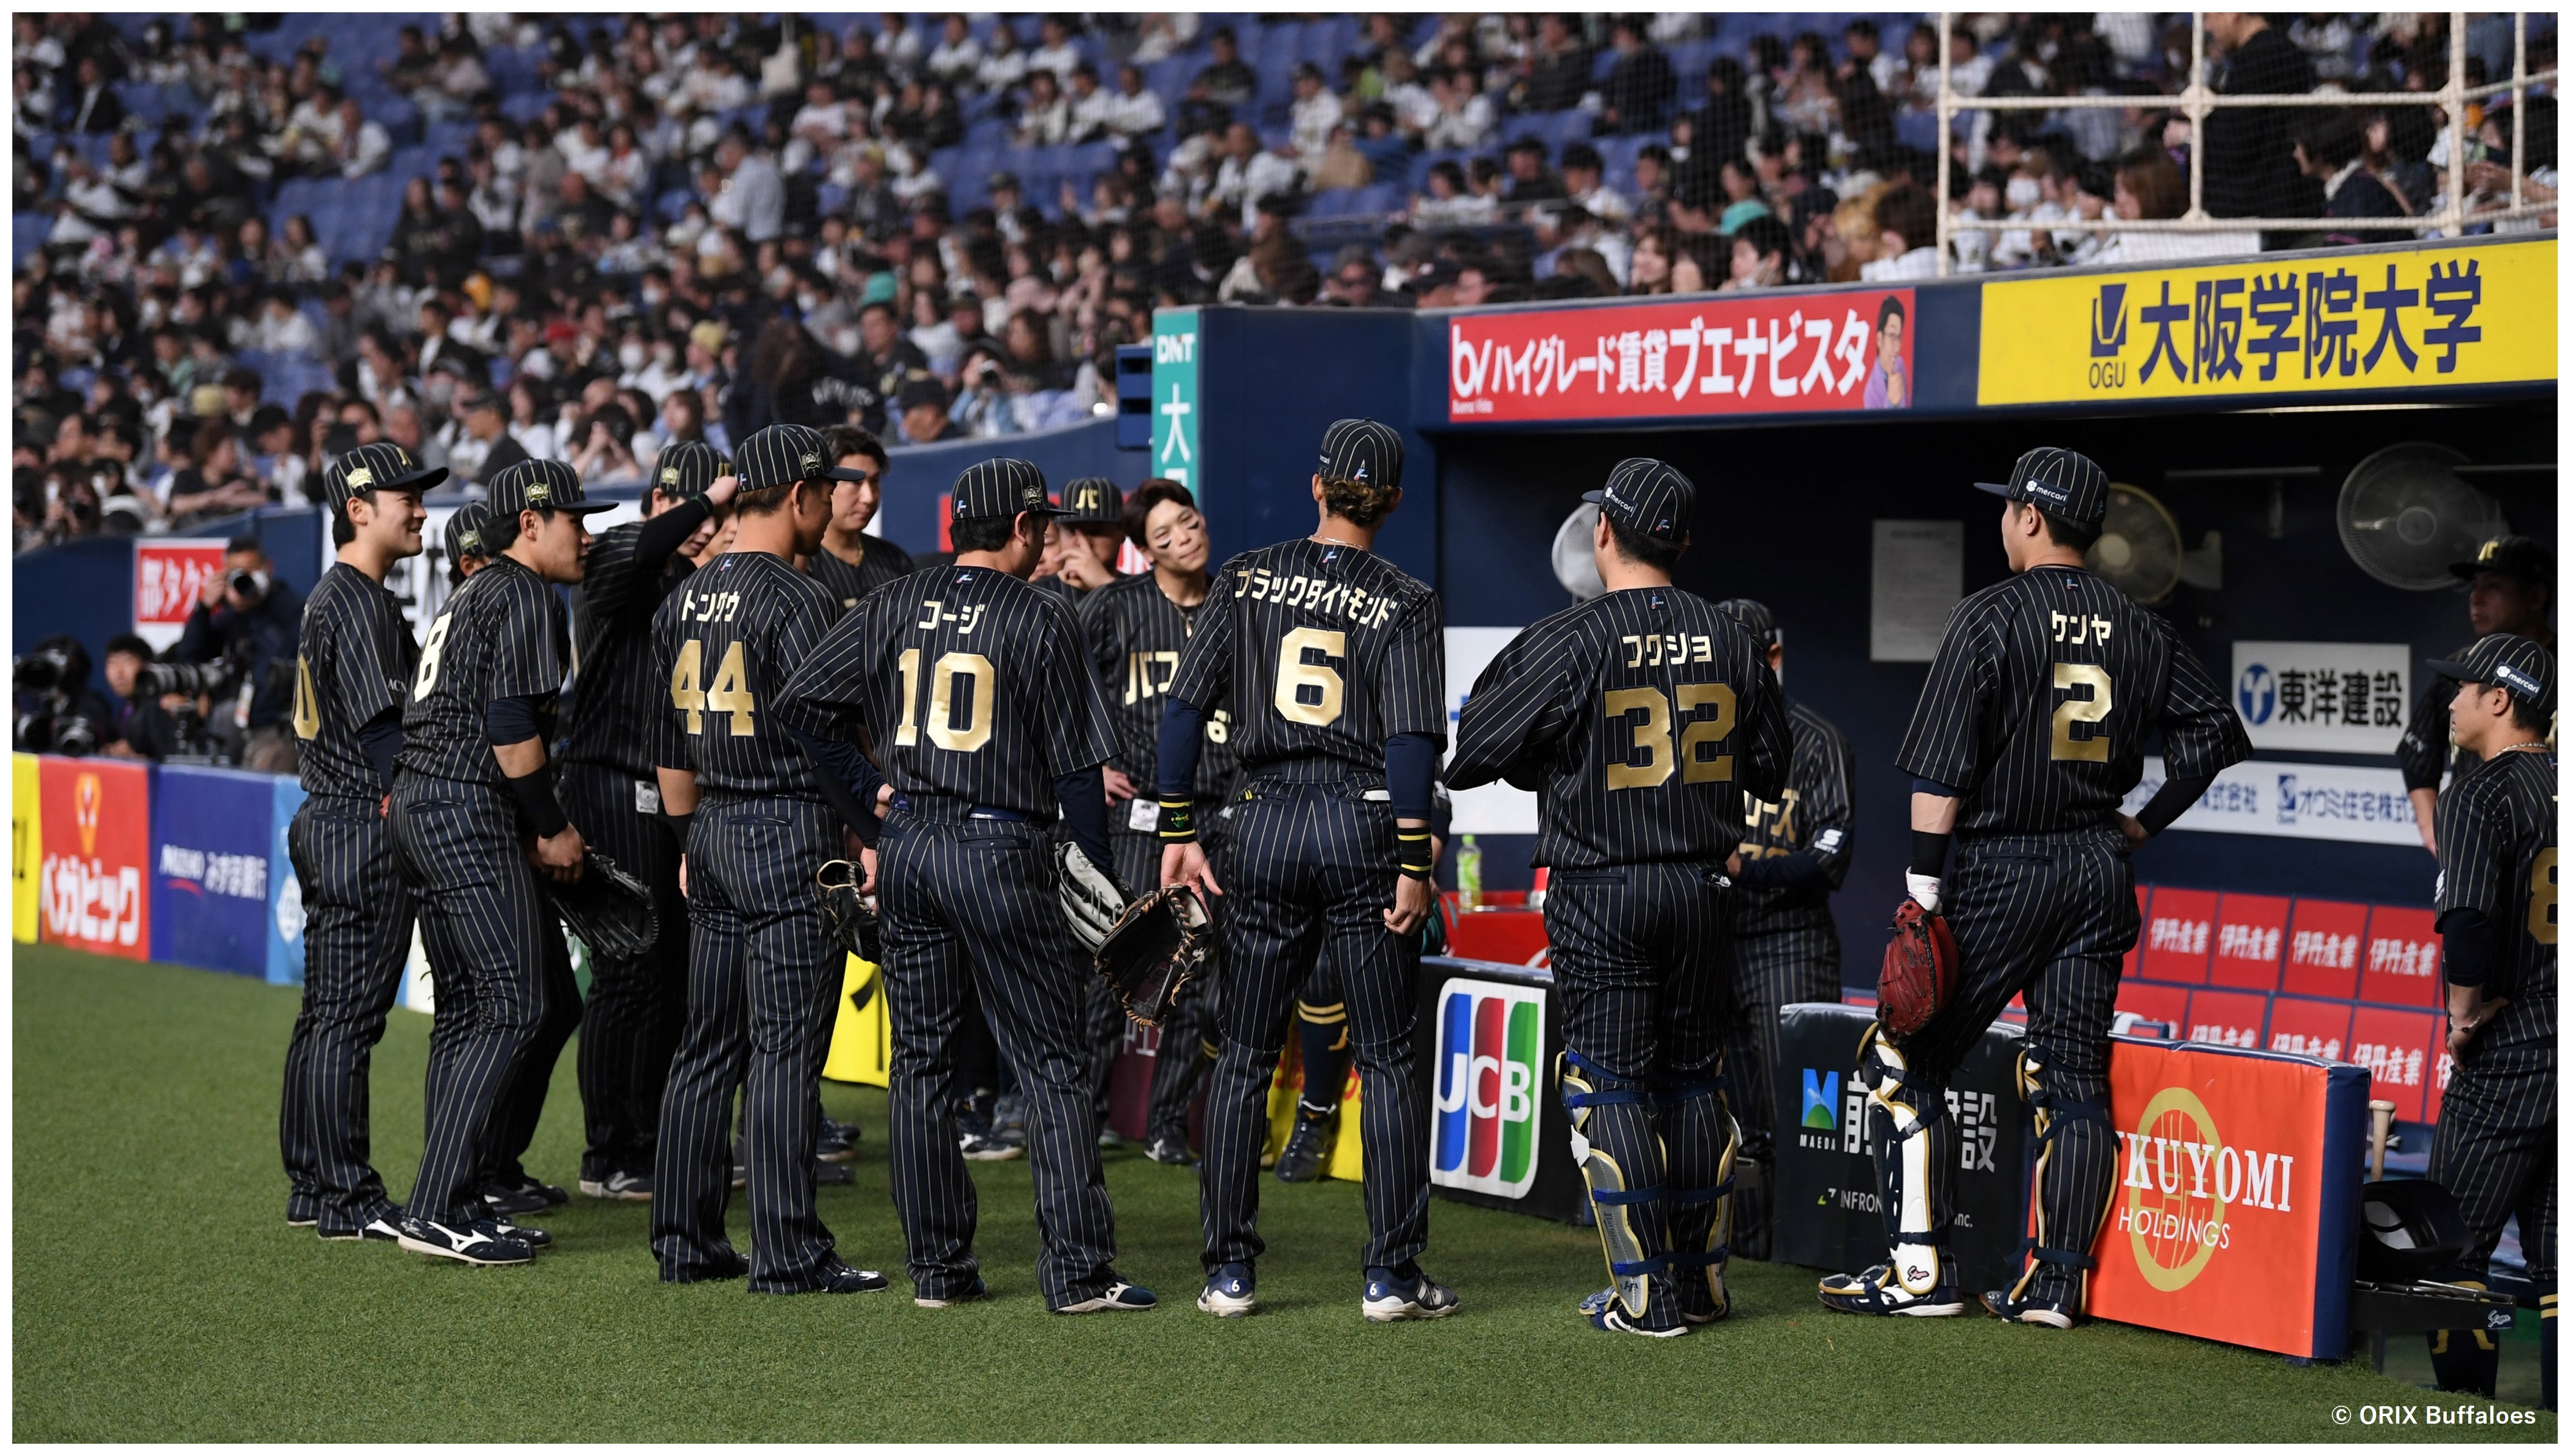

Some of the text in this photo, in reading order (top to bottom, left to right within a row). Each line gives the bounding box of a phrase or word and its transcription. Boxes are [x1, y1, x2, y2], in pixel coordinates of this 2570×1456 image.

[2138, 259, 2481, 385] 大阪学院大学
[2089, 362, 2126, 389] OGU
[1610, 493, 1634, 513] mercari
[2037, 486, 2067, 502] mercari
[918, 600, 985, 634] コージ
[1235, 567, 1397, 629] ブラックダイヤモンド
[2052, 610, 2112, 646] ケンヤ
[414, 611, 452, 702] 8
[1274, 626, 1346, 727] 6
[671, 639, 754, 736] 44
[894, 648, 995, 752] 10
[2279, 668, 2403, 727] 東洋建設
[2508, 673, 2540, 694] mercari
[1604, 683, 1736, 790] 32
[2051, 662, 2112, 762] 2
[1438, 1052, 1531, 1123] JCB
[1799, 1134, 1836, 1151] MAEDA
[2118, 1207, 2231, 1249] HOLDINGS
[1231, 1280, 1240, 1293] 6
[1369, 1283, 1378, 1296] 6
